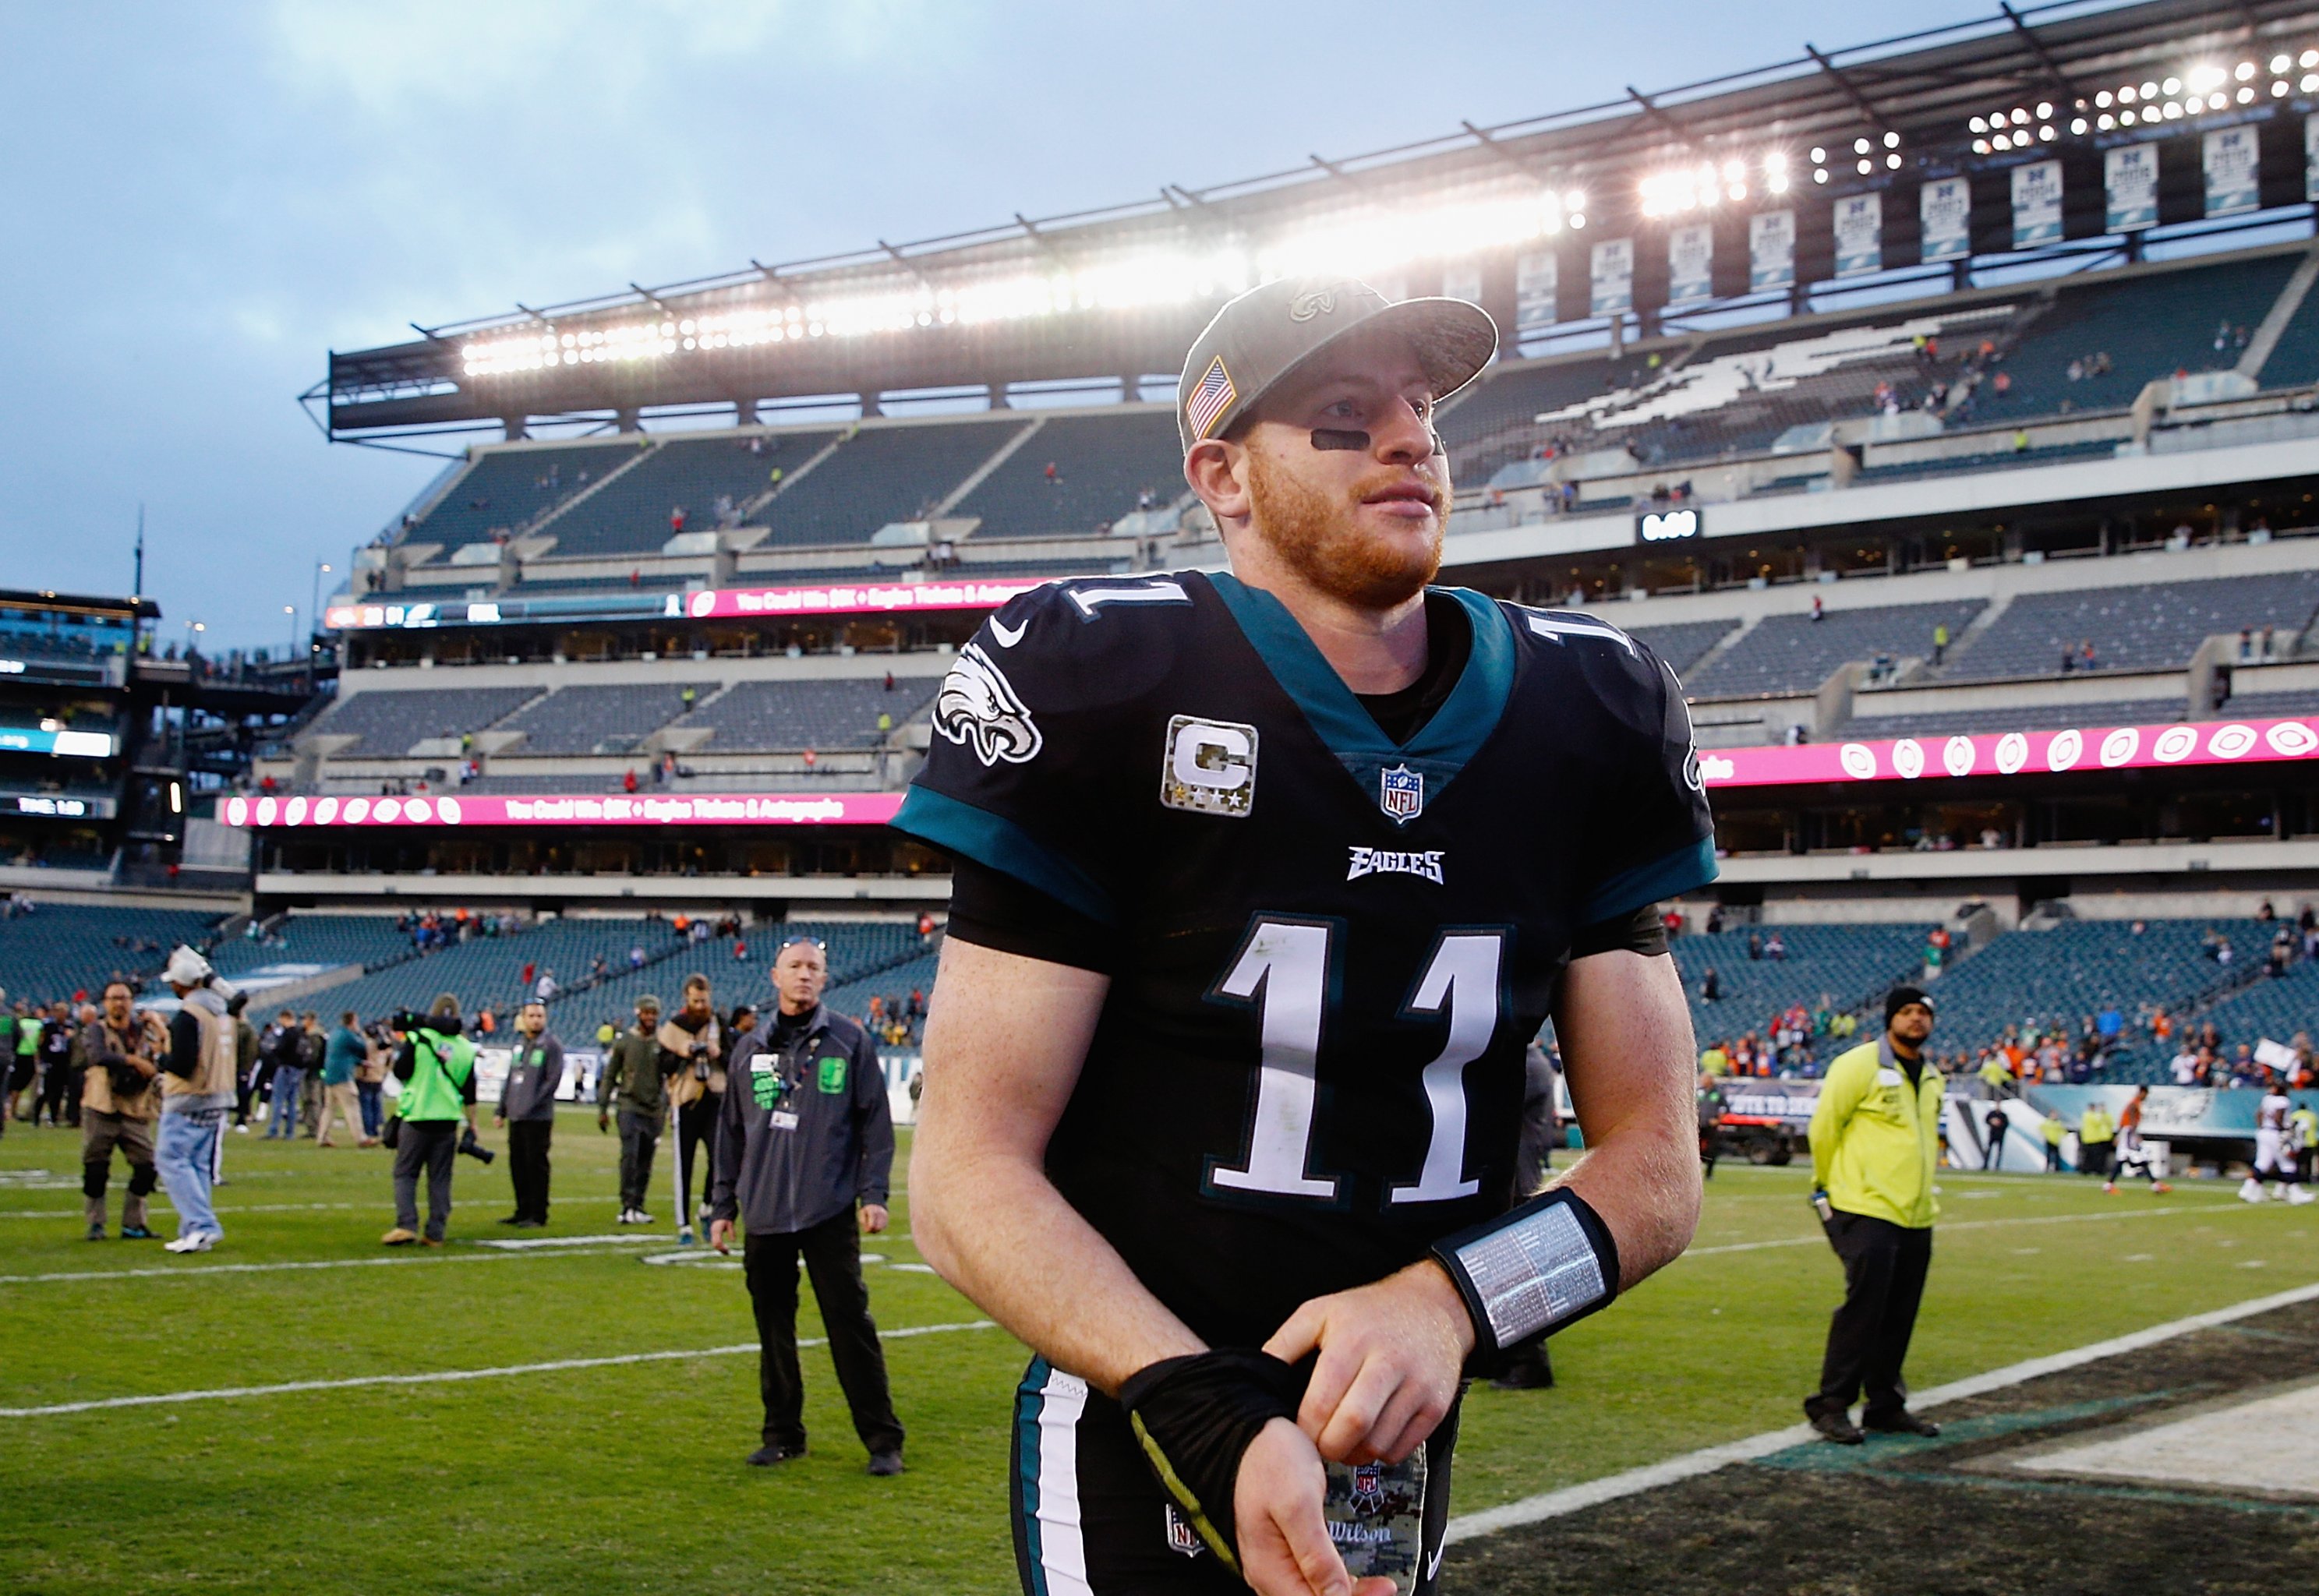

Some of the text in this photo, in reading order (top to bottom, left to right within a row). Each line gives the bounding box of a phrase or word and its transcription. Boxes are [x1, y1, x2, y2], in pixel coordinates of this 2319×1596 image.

[763, 591, 801, 609] Could
[1173, 724, 1251, 790] C
[506, 800, 533, 819] You
[534, 799, 574, 819] Could
[644, 799, 692, 823] Eagles
[693, 798, 746, 818] Tickets
[760, 798, 844, 823] Autographs
[1388, 789, 1417, 813] NFL
[1347, 846, 1445, 885] EAGLES
[1210, 920, 1506, 1206] 11
[1356, 1475, 1377, 1492] NFL
[1327, 1521, 1391, 1542] Wilson
